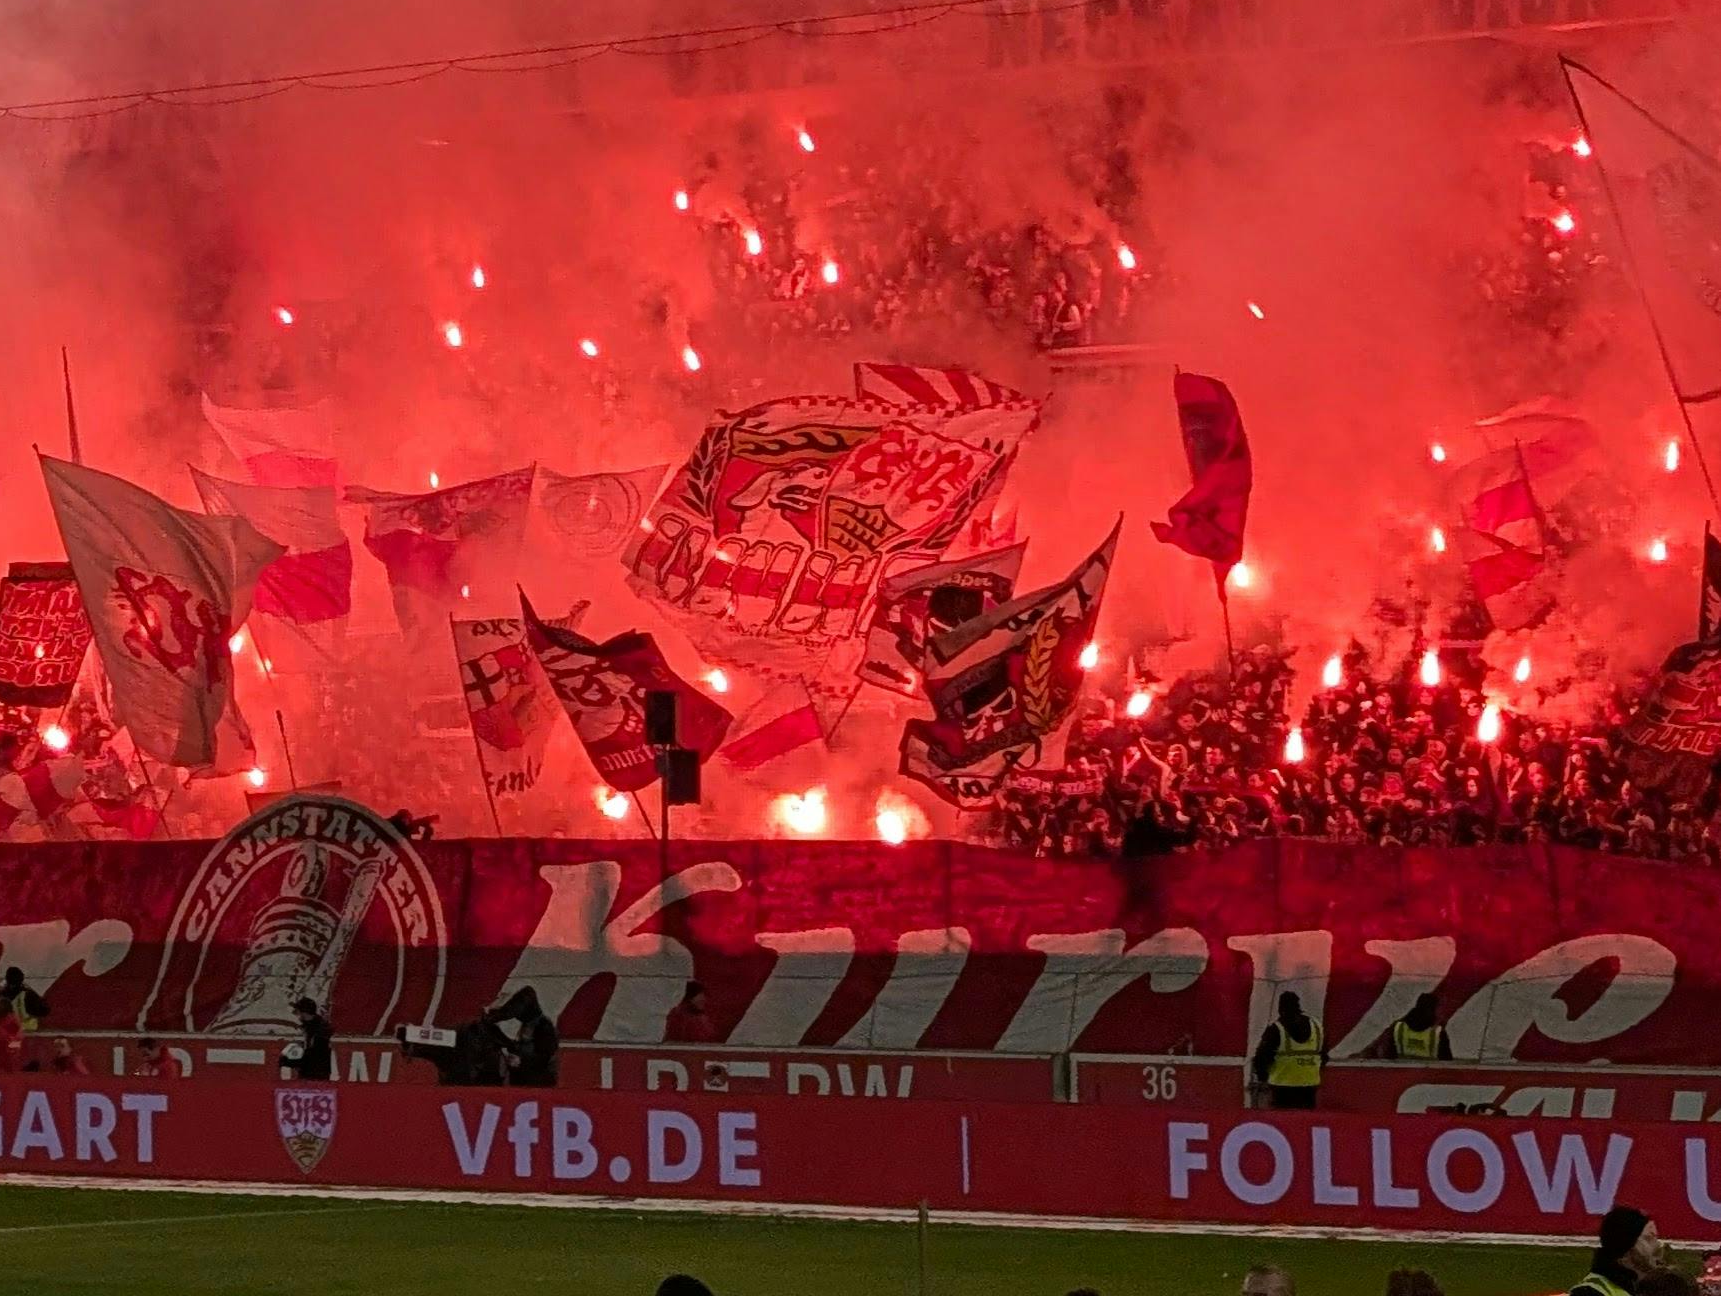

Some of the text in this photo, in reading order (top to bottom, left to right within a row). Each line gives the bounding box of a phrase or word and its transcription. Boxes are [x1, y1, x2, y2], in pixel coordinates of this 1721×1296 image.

[185, 806, 430, 947] CANNSTATTER
[484, 860, 1678, 1062] Kurve
[1142, 1064, 1178, 1102] 36
[441, 1100, 762, 1188] VfB.DE
[1167, 1121, 1634, 1216] FOLLOW
